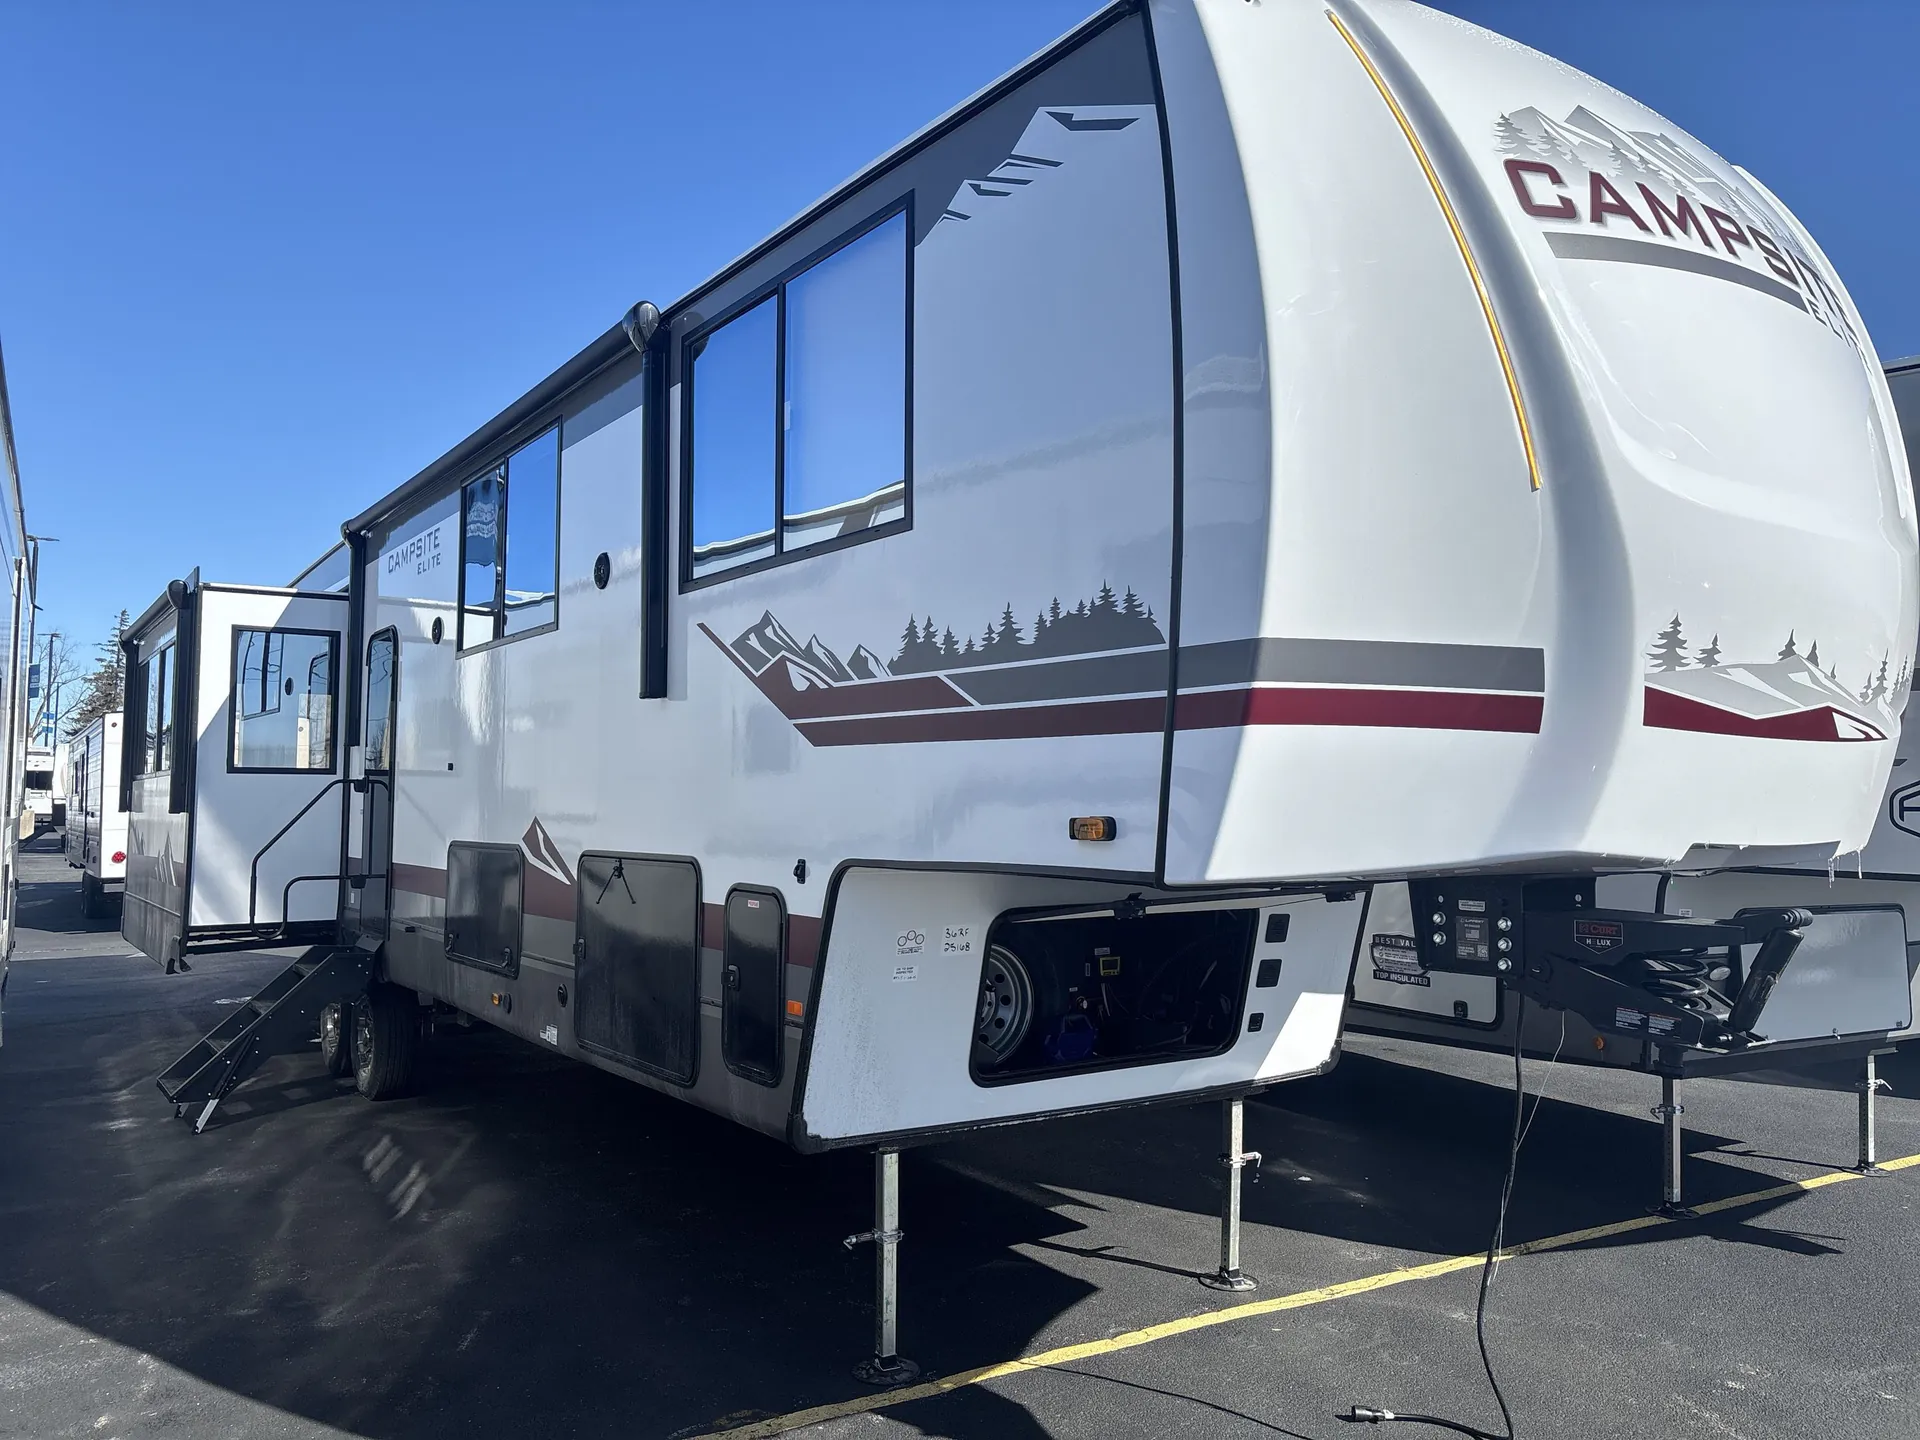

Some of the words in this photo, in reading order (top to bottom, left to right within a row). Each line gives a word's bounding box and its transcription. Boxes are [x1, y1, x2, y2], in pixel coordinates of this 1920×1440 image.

[1503, 158, 1860, 346] CAMPSITE
[387, 526, 441, 574] CAMPSITE
[417, 552, 441, 575] ELITE
[1375, 936, 1396, 945] BEST
[1375, 971, 1389, 979] TOP
[1390, 973, 1428, 985] INSULATED
